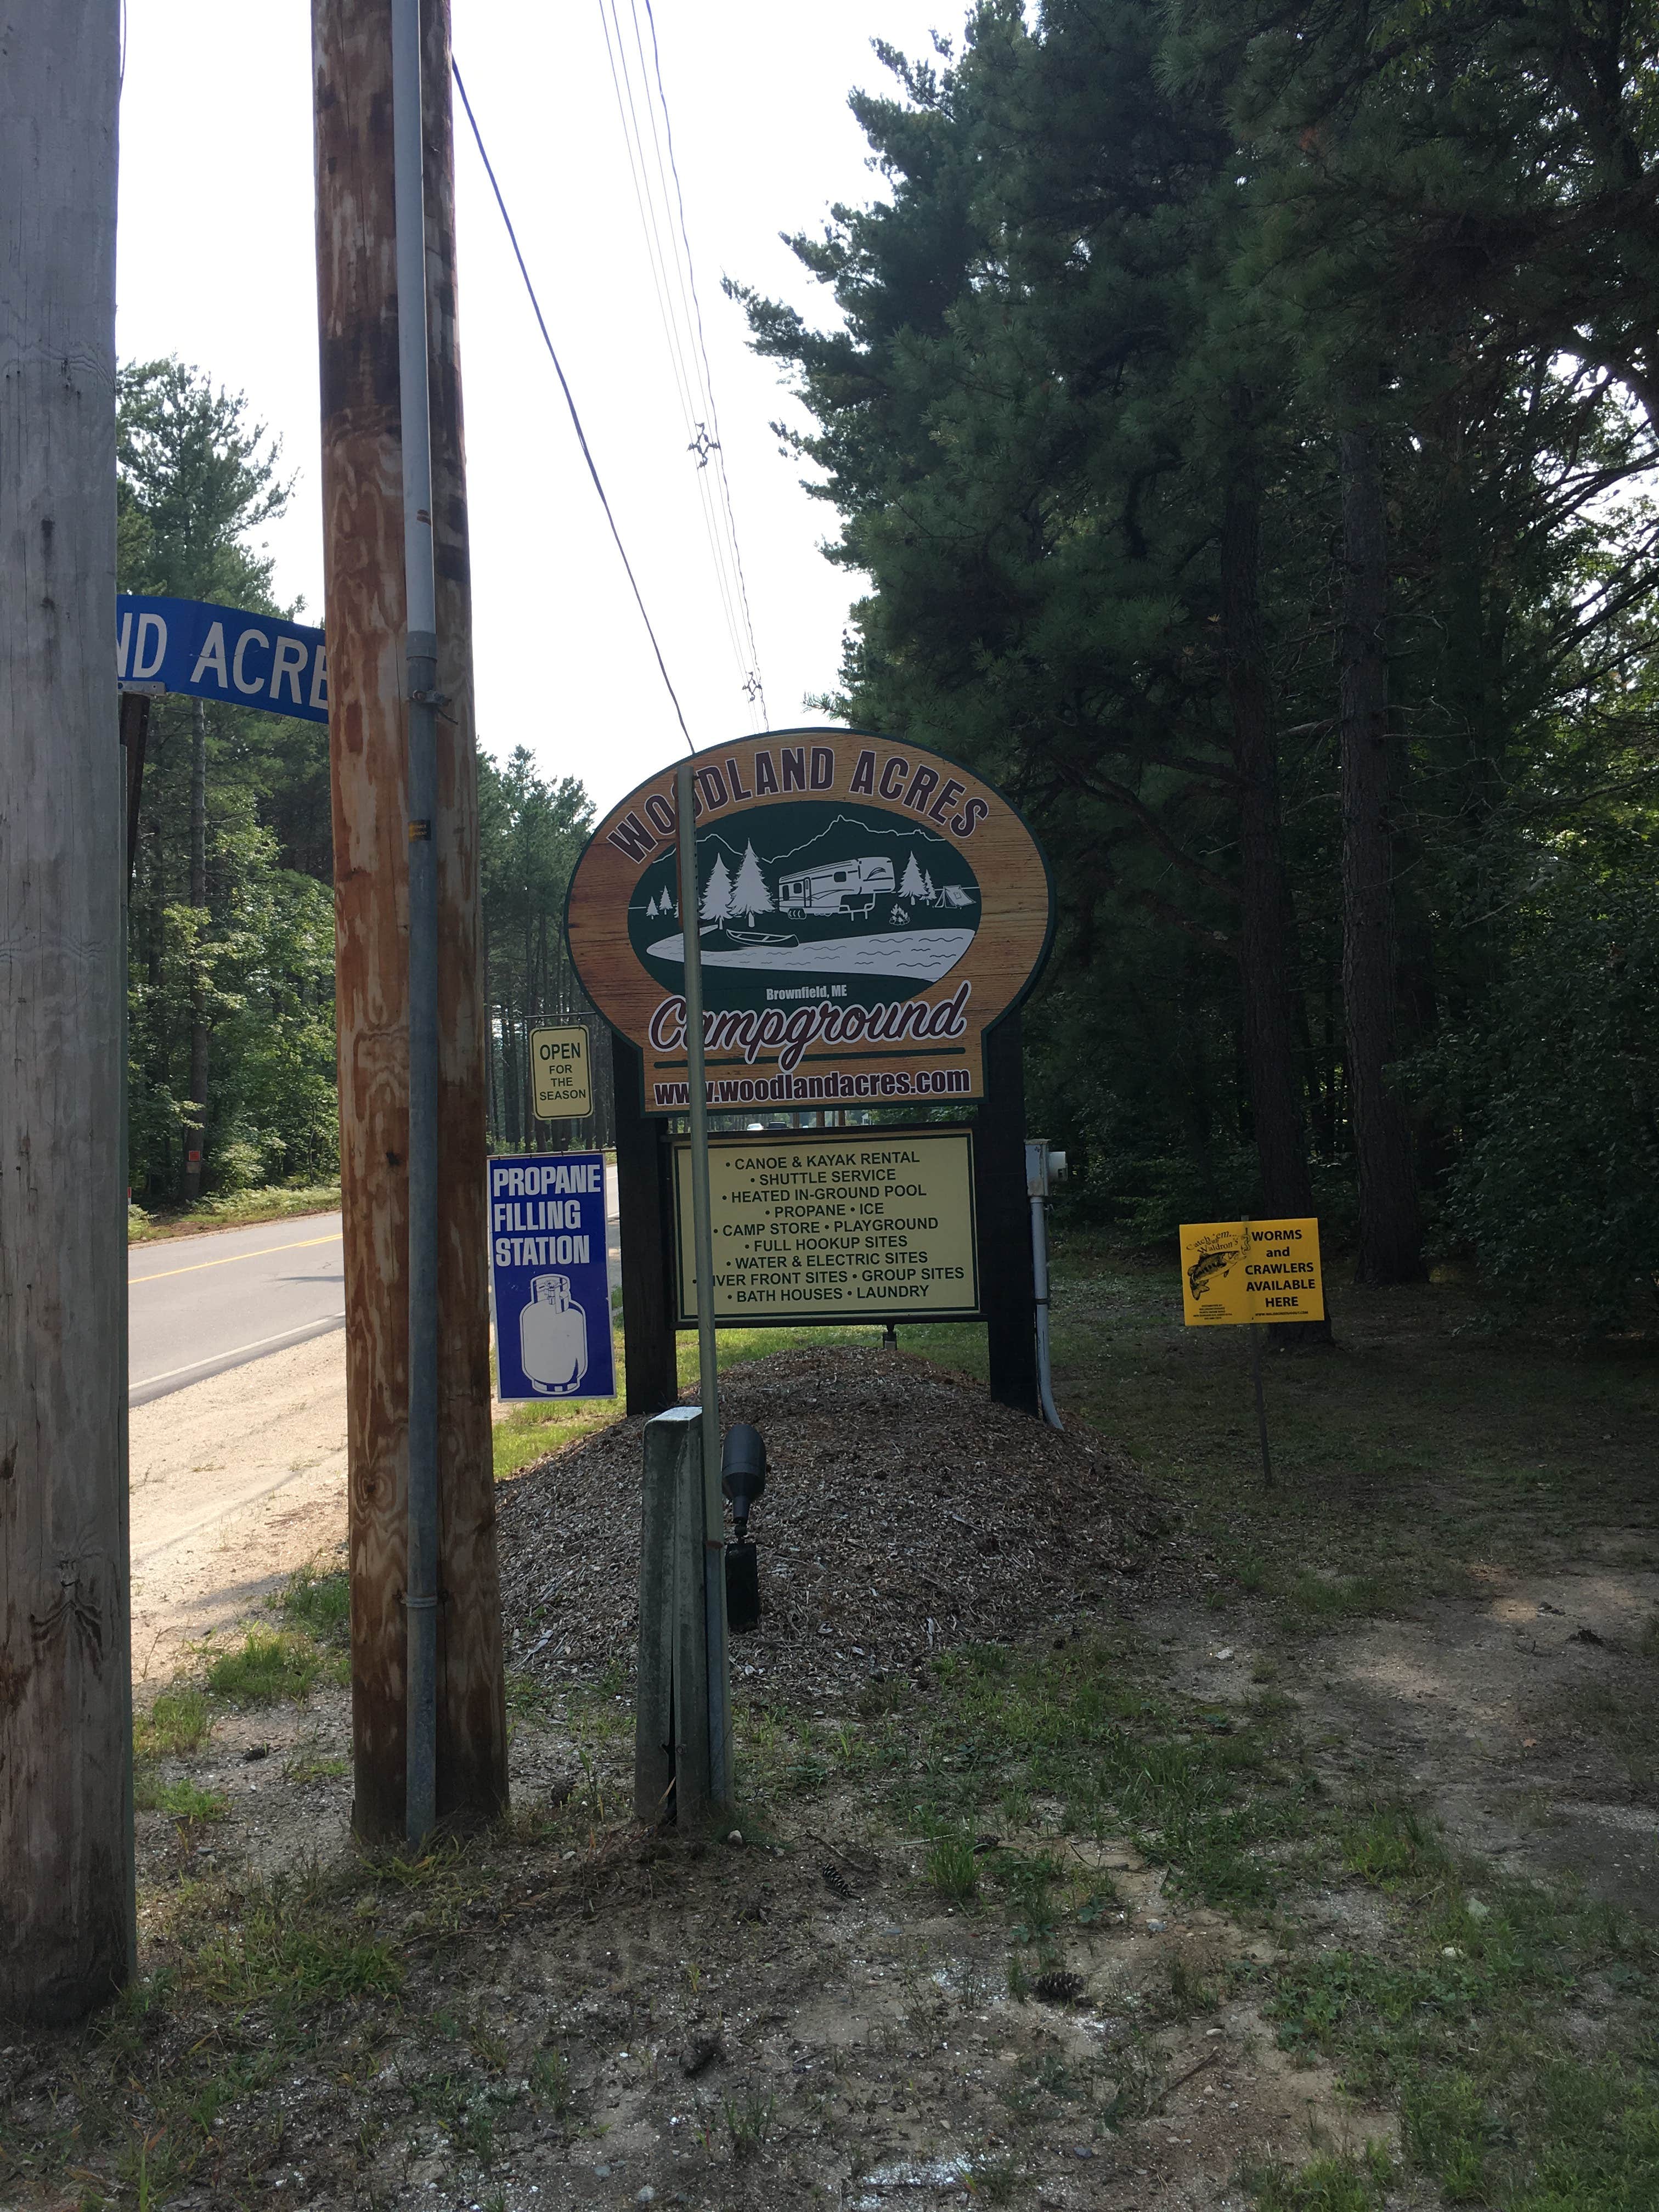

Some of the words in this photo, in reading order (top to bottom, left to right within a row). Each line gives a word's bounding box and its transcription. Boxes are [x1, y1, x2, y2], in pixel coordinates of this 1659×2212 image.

[850, 749, 989, 839] ACRES
[766, 986, 830, 1000] Brownfield,
[831, 985, 848, 997] ME
[648, 980, 972, 1074] Campground
[540, 1042, 580, 1060] OPEN
[549, 1064, 572, 1074] FOR
[550, 1077, 573, 1086] THE
[539, 1089, 586, 1101] SEASON
[735, 1156, 787, 1170] CANOE
[792, 1156, 802, 1168] &
[806, 1154, 856, 1167] KAYAK
[860, 1151, 920, 1165] RENTAL
[494, 1164, 601, 1197] PROPANE
[759, 1171, 827, 1186] SHUTTLE
[831, 1169, 896, 1183] SERVICE
[731, 1189, 790, 1203] HEATED
[795, 1186, 879, 1201] IN-GROUND
[884, 1184, 927, 1197] POOL
[494, 1199, 581, 1232] FILLING
[775, 1204, 846, 1218] PROPANE
[860, 1203, 884, 1215] ICE
[723, 1223, 765, 1237] CAMP
[770, 1221, 820, 1235] STORE
[834, 1217, 938, 1232] PLAYGROUND
[1251, 1229, 1302, 1242] WORMS
[495, 1234, 590, 1267] STATION
[754, 1239, 792, 1252] FULL
[795, 1237, 860, 1250] HOOKUP
[865, 1235, 907, 1248] SITES
[1186, 1236, 1210, 1250] Catch
[1197, 1238, 1238, 1254] Waldron's
[1266, 1246, 1290, 1257] and
[735, 1256, 787, 1269] WATER
[792, 1256, 802, 1267] &
[806, 1252, 880, 1267] ELECTRIC
[885, 1251, 928, 1265] SITES
[1245, 1262, 1314, 1275] CRAWLERS
[713, 1274, 746, 1286] IVER
[751, 1272, 801, 1285] FRONT
[805, 1271, 848, 1284] SITES
[862, 1268, 916, 1282] GROUP
[921, 1267, 964, 1280] SITES
[1246, 1279, 1316, 1291] AVAILABLE
[737, 1290, 776, 1302] BATH
[781, 1288, 843, 1301] HOUSES
[857, 1285, 929, 1299] LAUNDRY
[1265, 1296, 1299, 1307] HERE
